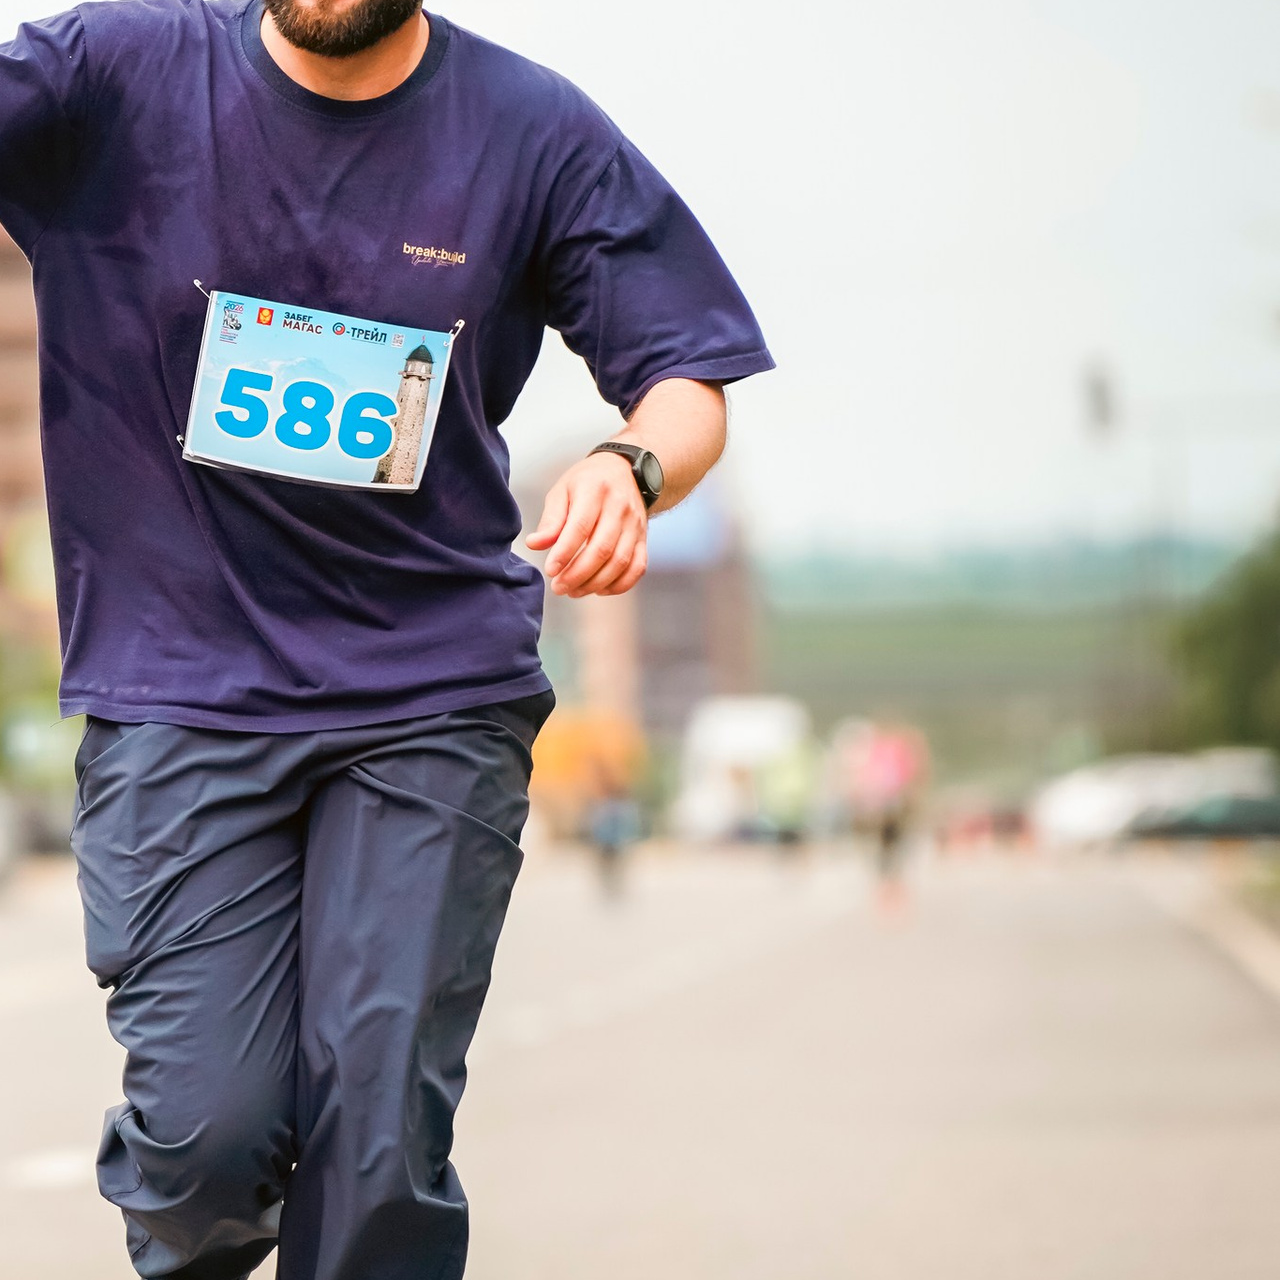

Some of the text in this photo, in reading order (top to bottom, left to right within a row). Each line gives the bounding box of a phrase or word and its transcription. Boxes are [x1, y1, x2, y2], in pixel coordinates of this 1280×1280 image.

[225, 302, 244, 312] 2026
[283, 311, 313, 323] ЗАБЕГ
[282, 319, 323, 335] МАГАС
[214, 367, 398, 460] 586
